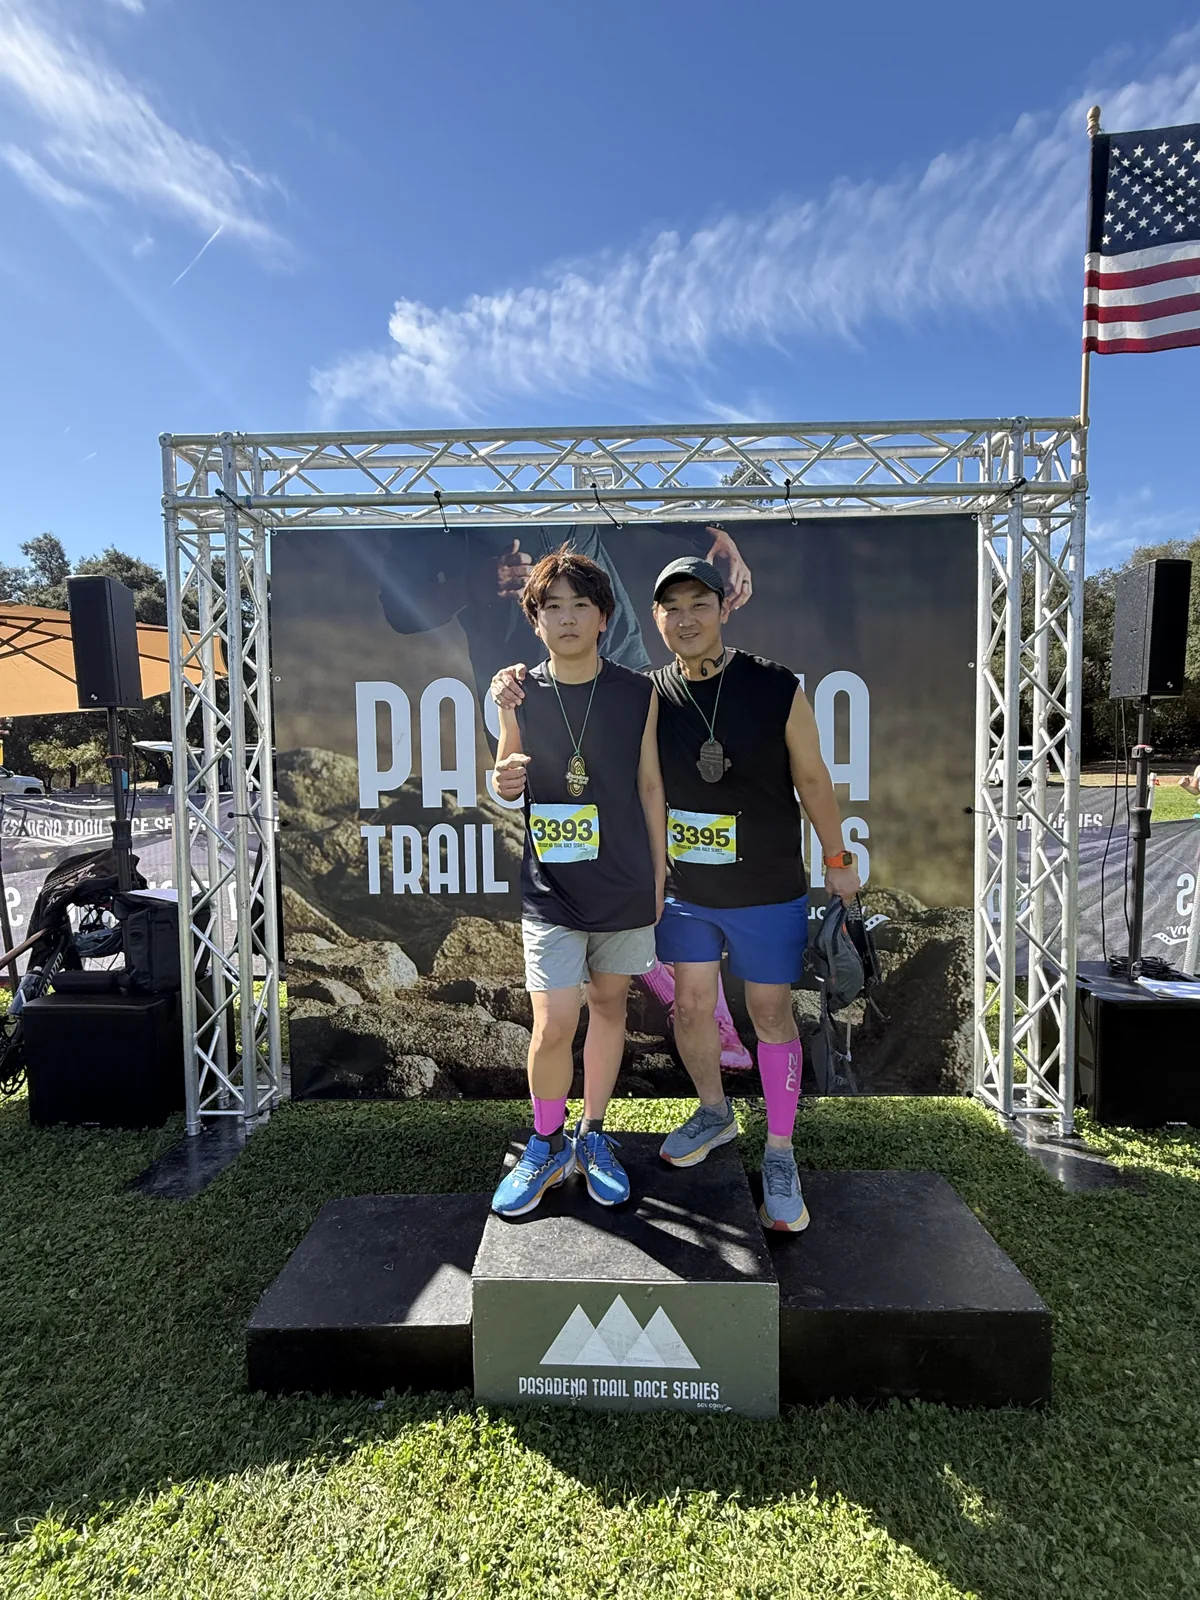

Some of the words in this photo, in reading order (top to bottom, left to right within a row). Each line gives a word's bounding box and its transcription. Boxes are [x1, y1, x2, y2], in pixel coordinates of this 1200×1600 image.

[533, 818, 594, 842] 3393
[672, 823, 731, 848] 3395
[360, 822, 509, 895] TRAIL
[518, 1376, 588, 1395] PASADENA
[592, 1378, 630, 1397] TRAIL
[634, 1380, 668, 1399] RACE
[673, 1381, 719, 1400] SERIES
